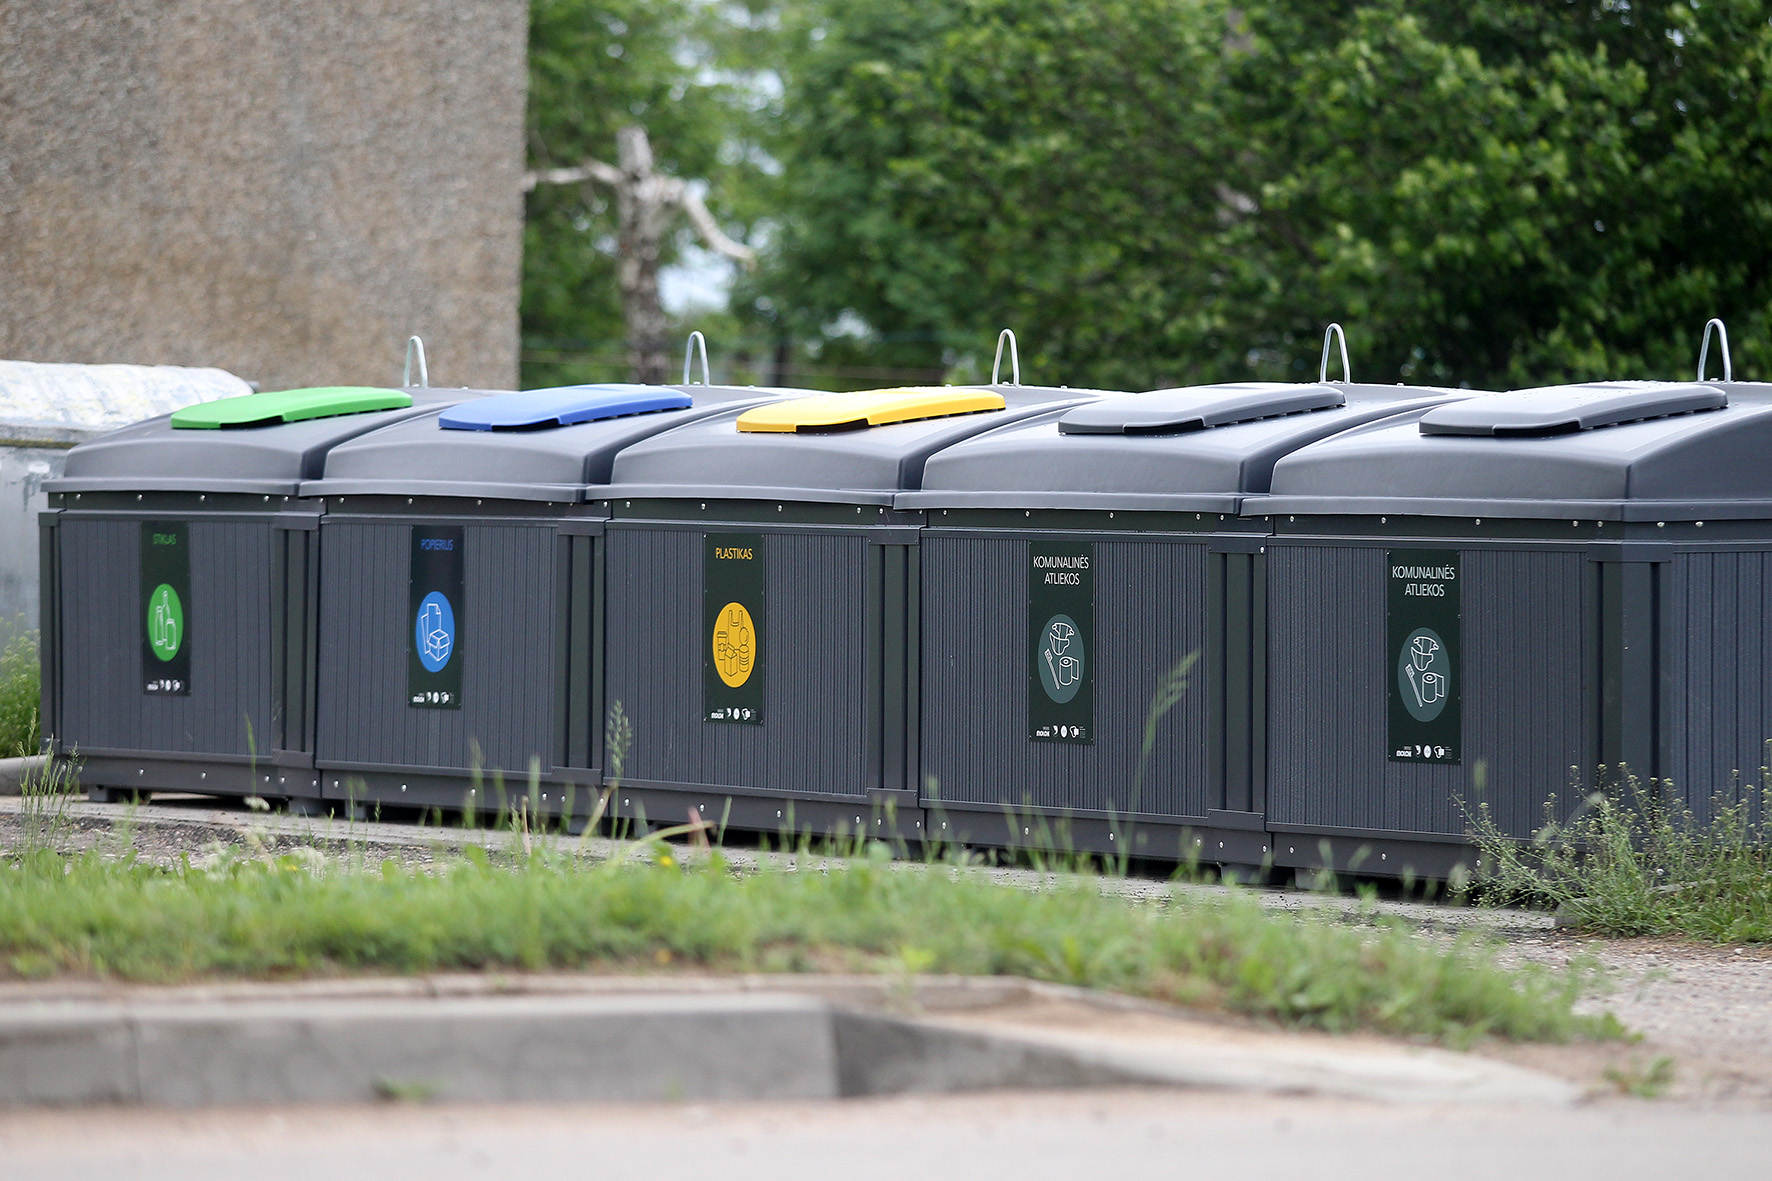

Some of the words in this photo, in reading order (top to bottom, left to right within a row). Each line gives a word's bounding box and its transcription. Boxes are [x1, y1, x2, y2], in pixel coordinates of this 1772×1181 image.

[715, 547, 753, 560] PLASTIKAS
[1033, 554, 1089, 569] KOMUNALINĖS
[1044, 572, 1080, 585] ATLIEKOS
[1392, 564, 1455, 580] KOMUNALINĖS
[1404, 583, 1445, 597] ATLIEKOS
